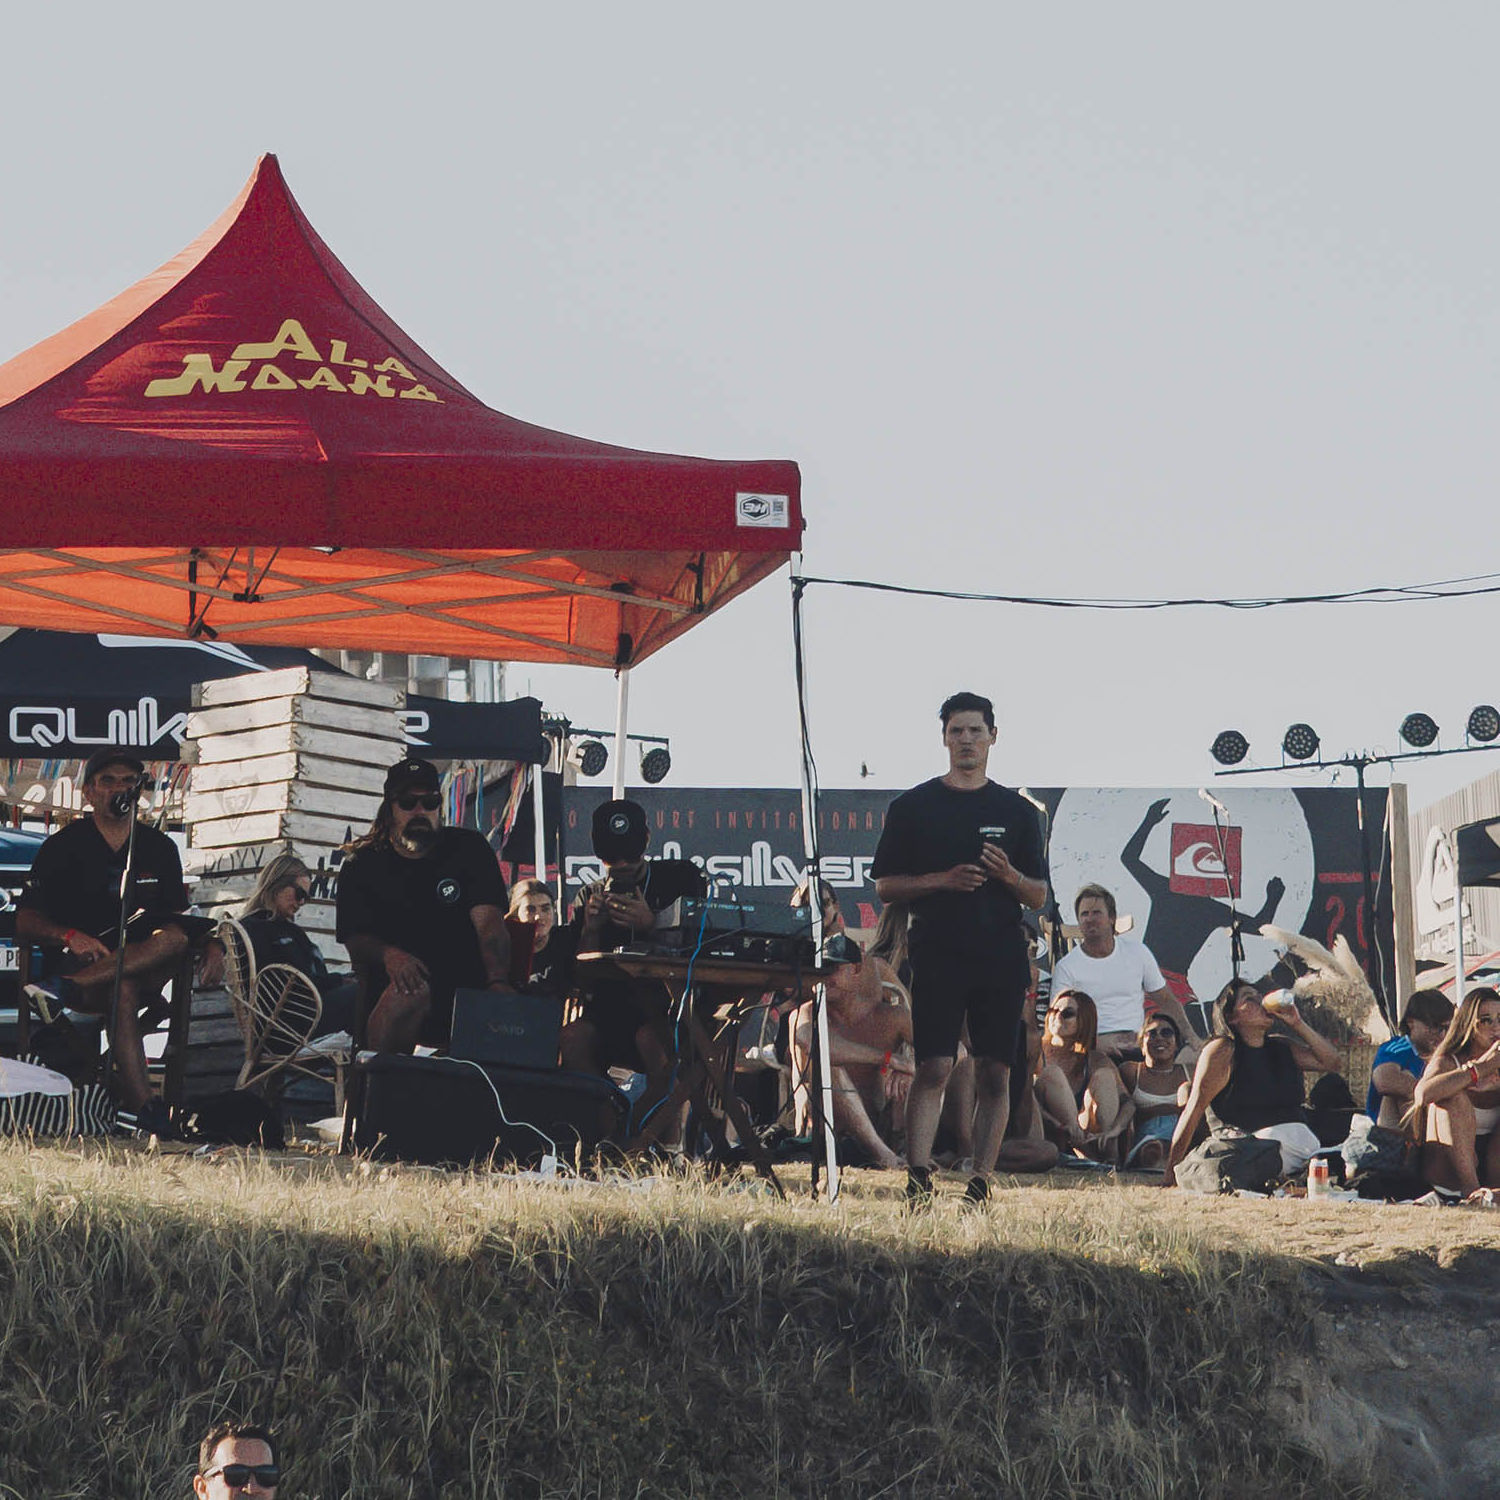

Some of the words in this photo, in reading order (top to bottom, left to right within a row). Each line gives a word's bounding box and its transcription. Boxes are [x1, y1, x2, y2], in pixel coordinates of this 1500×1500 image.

[231, 319, 417, 380] ALA
[144, 354, 446, 404] MOANA
[646, 810, 696, 829] URF
[715, 810, 886, 830] INVITAIONA
